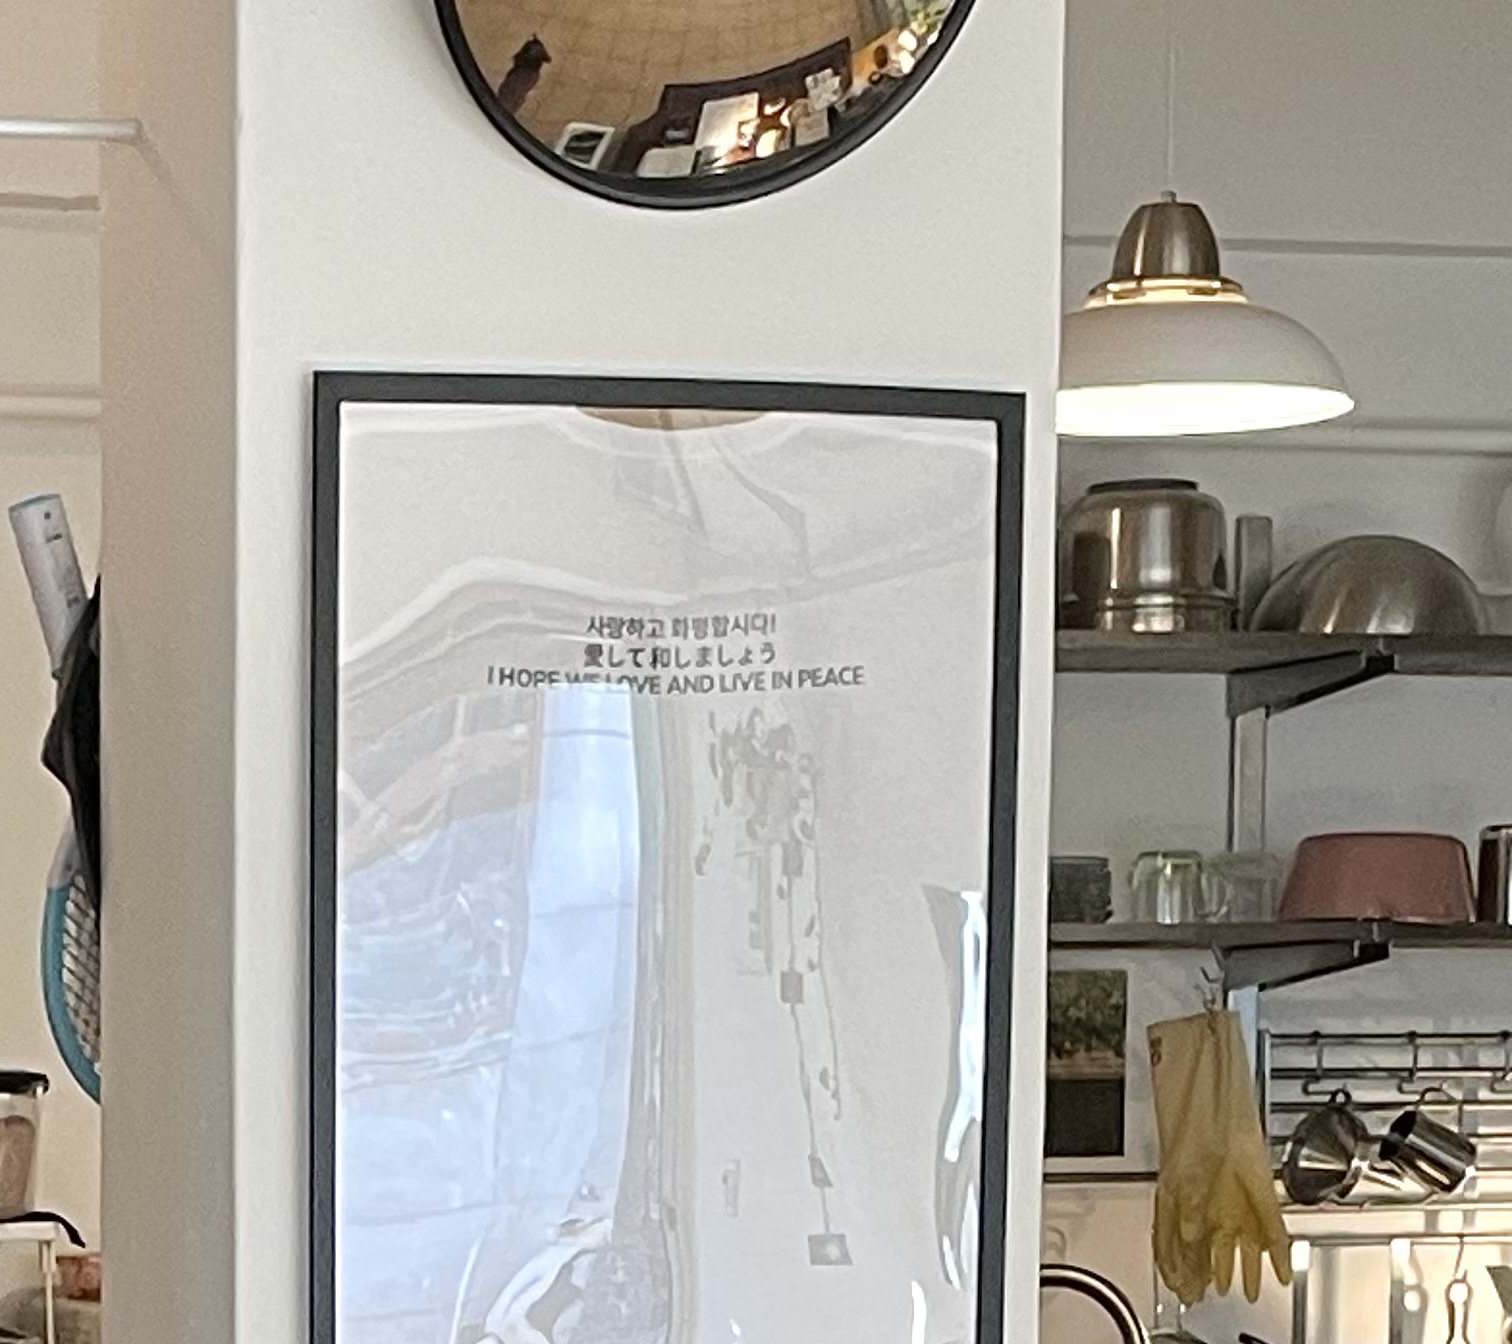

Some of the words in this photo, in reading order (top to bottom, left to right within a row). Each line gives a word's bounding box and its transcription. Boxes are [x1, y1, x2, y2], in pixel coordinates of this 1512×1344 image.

[587, 614, 665, 640] 사랑하고
[488, 665, 494, 685] I
[499, 667, 561, 688] HOPE
[667, 674, 714, 695] AND
[719, 671, 767, 694] LIVE
[771, 670, 793, 690] IN
[798, 665, 865, 688] PEACE
